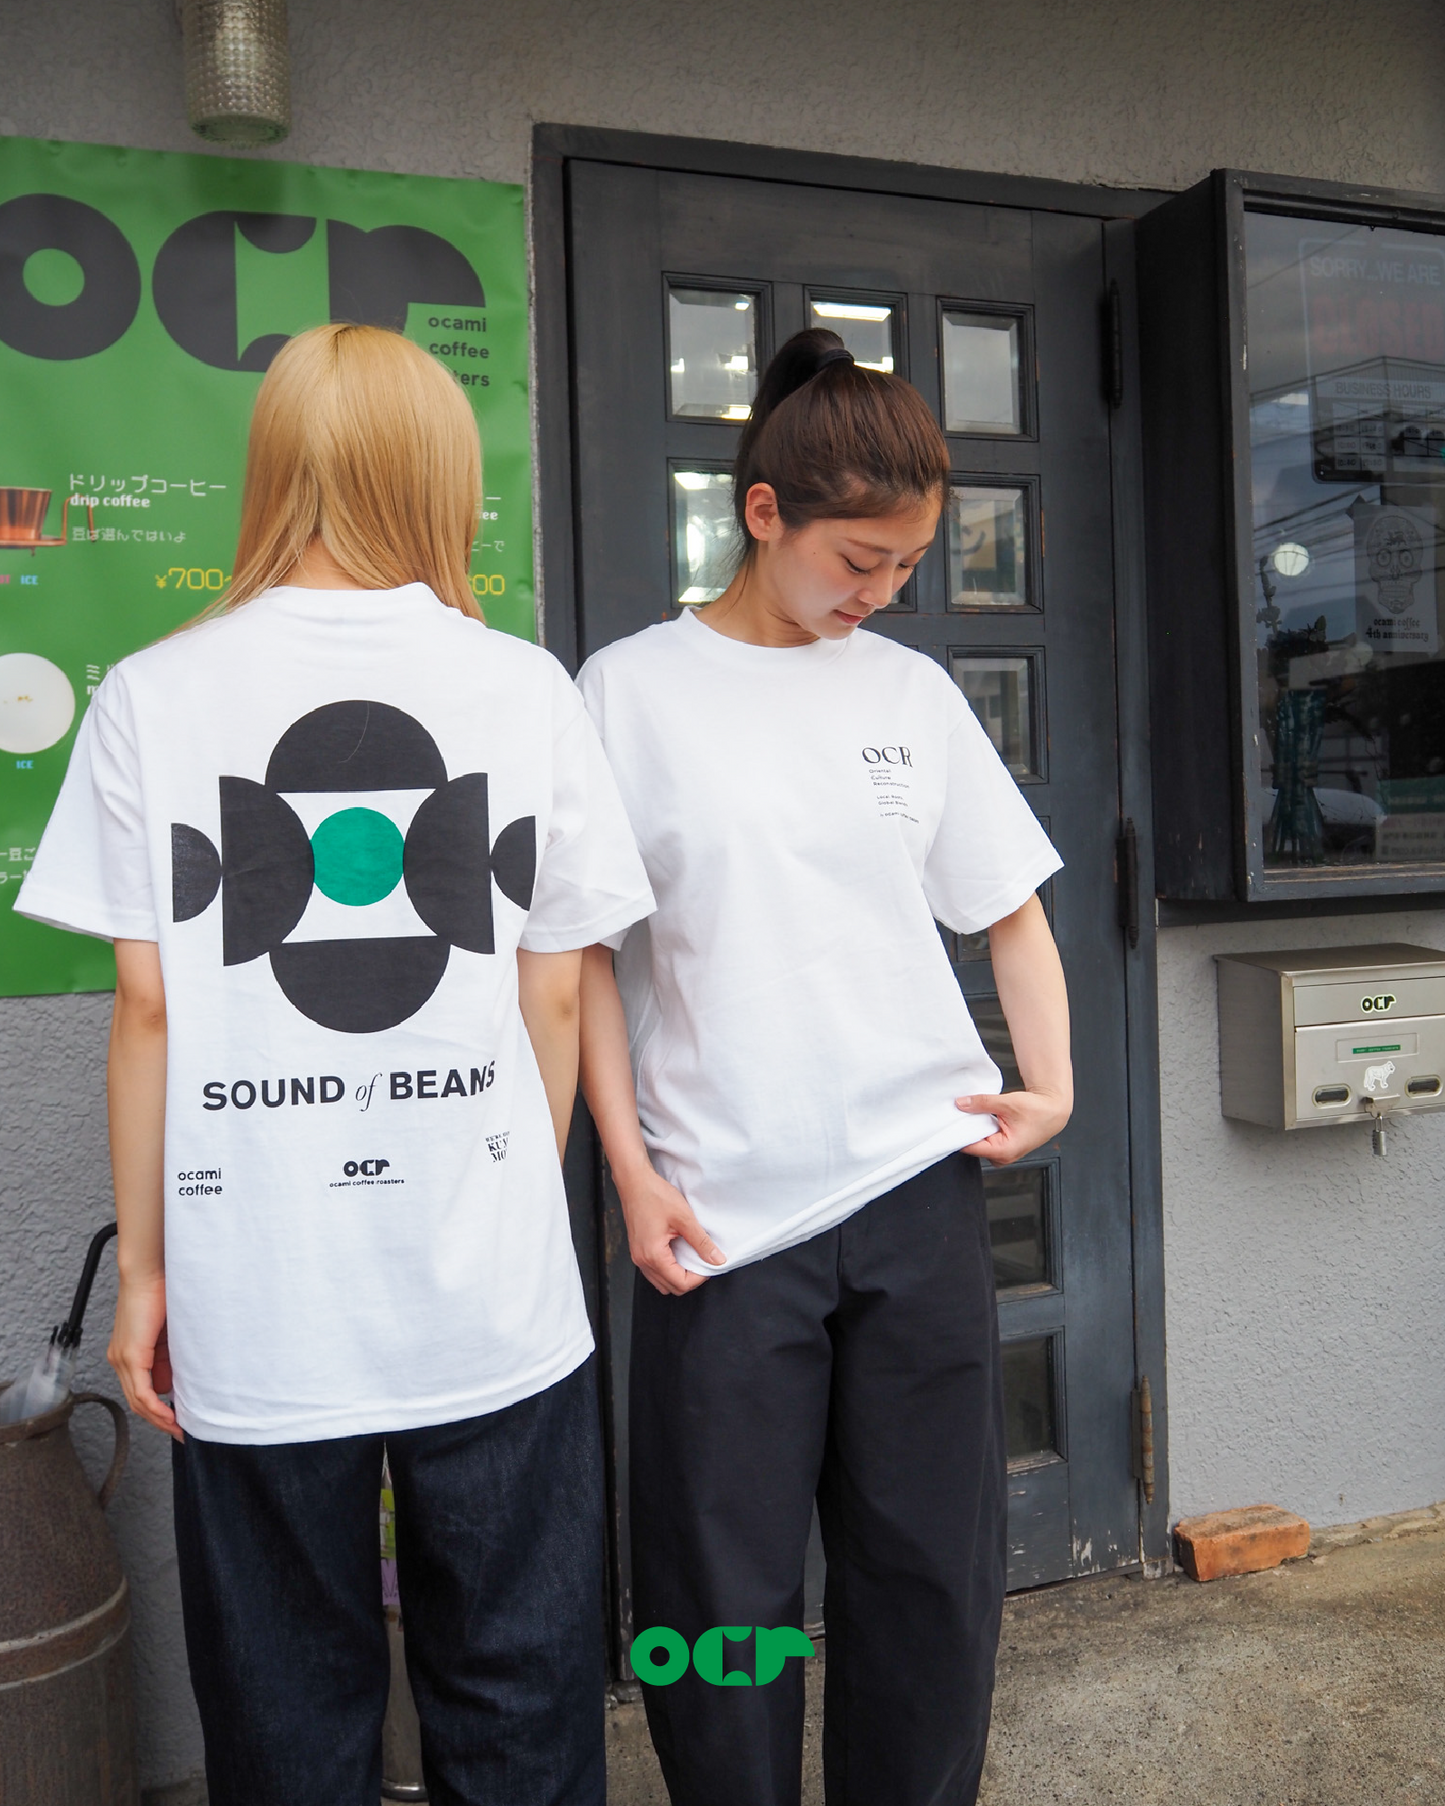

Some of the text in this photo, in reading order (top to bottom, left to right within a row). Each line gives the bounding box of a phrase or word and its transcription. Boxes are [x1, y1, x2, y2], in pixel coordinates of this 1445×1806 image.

[0, 193, 486, 372] ocr
[1406, 264, 1441, 286] ARE
[428, 317, 487, 332] ocami
[1313, 294, 1444, 360] CLOSED
[429, 341, 490, 359] coffee
[1336, 382, 1432, 399] BUSINESS HOURS
[70, 473, 227, 496] ドリップコーヒー
[70, 493, 151, 508] drip coffee
[21, 574, 39, 585] ICE
[16, 760, 34, 769] ICE
[862, 746, 913, 768] OCR
[1362, 995, 1395, 1011] ocr
[202, 1060, 496, 1112] SOUND of BEANS
[178, 1168, 222, 1181] ocami
[343, 1159, 390, 1178] ocr
[178, 1183, 223, 1197] coffee
[329, 1178, 405, 1188] ocami coffee roasters
